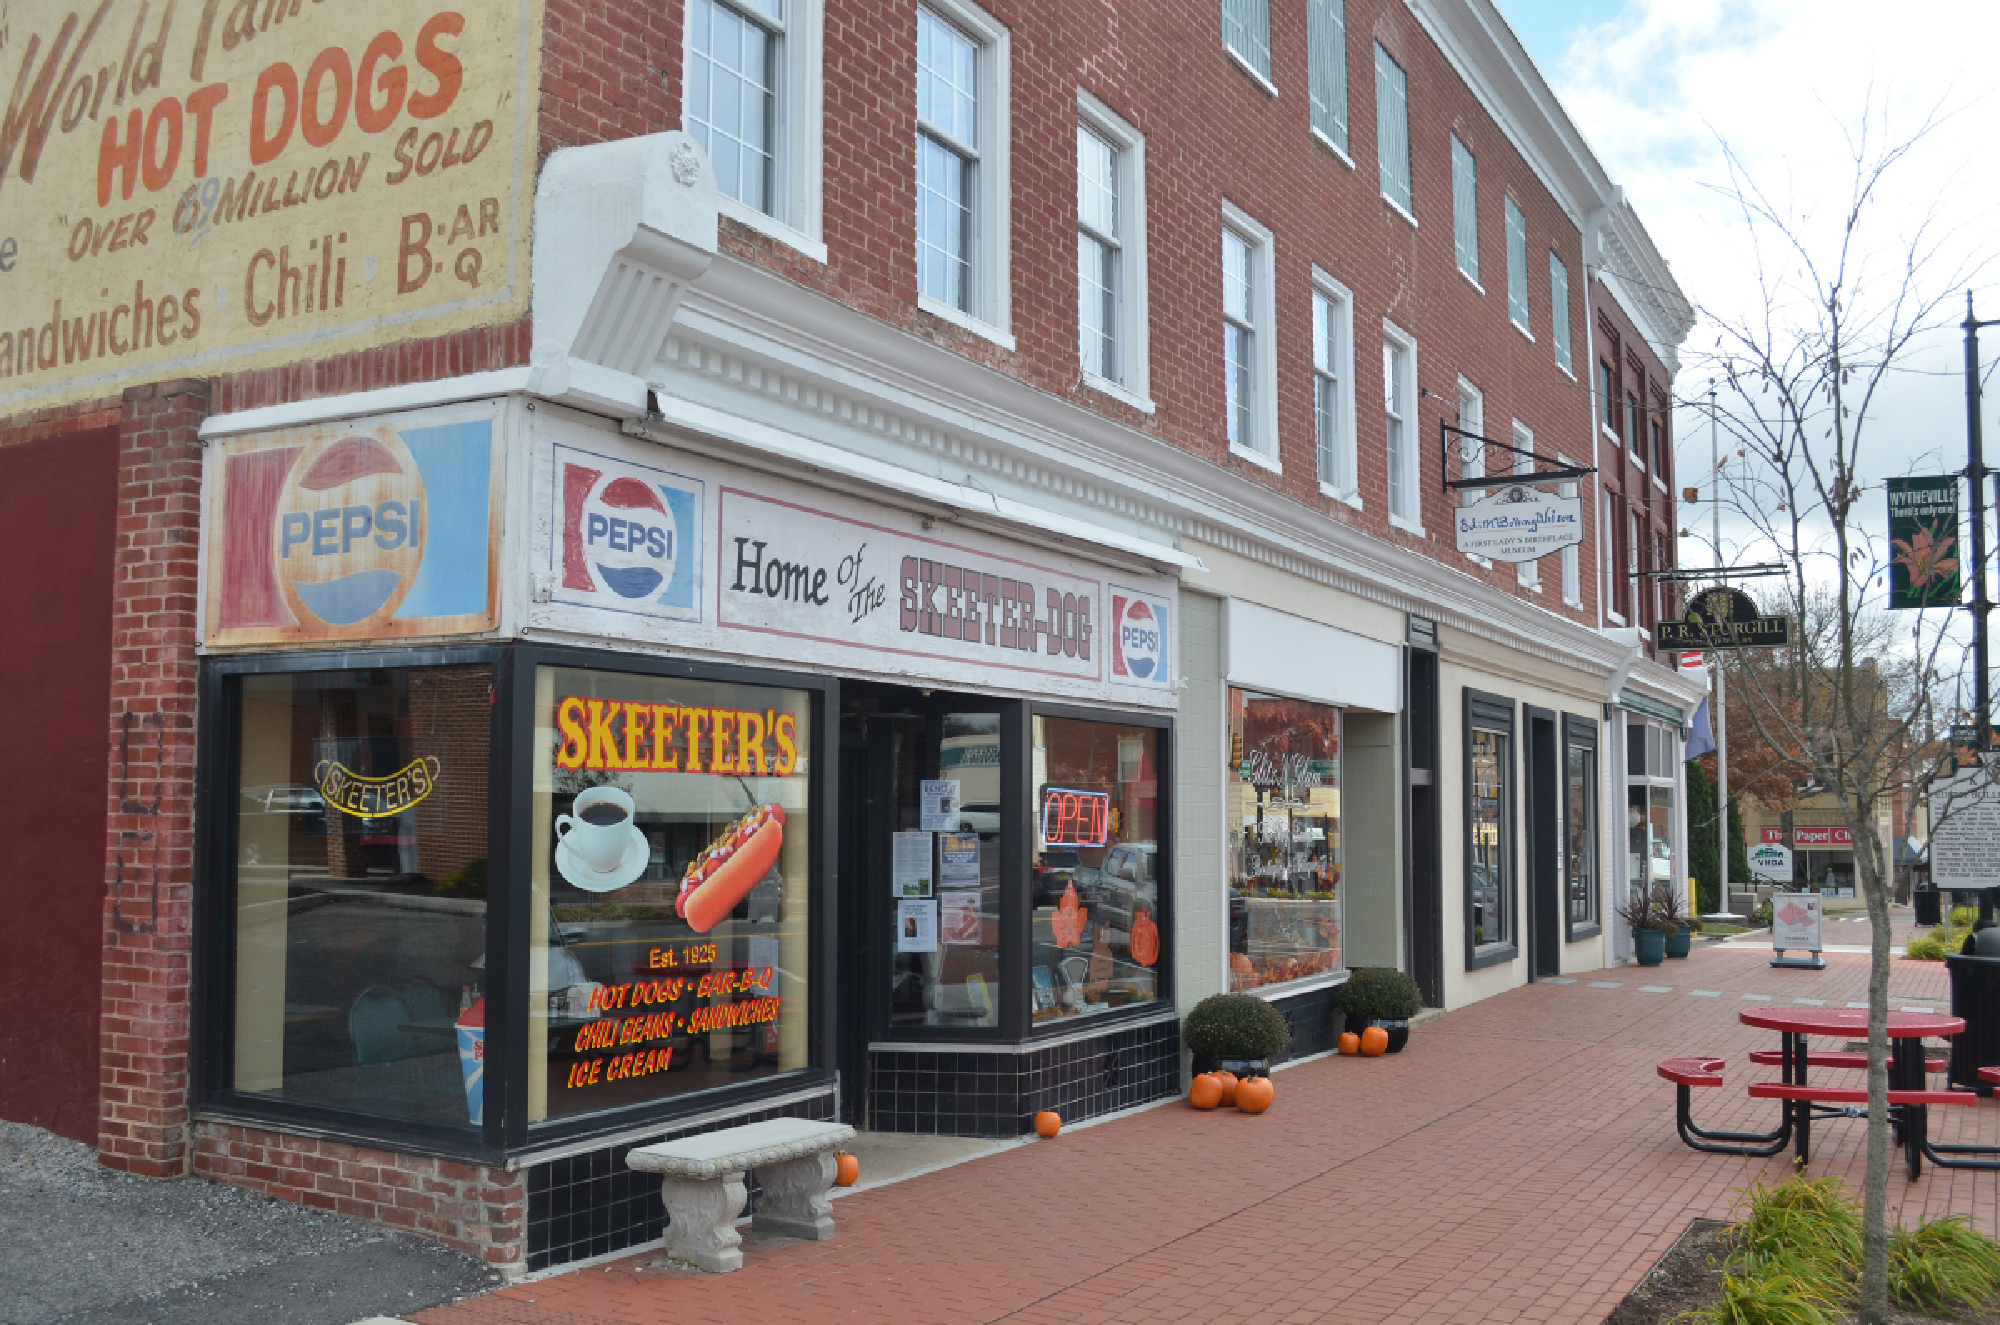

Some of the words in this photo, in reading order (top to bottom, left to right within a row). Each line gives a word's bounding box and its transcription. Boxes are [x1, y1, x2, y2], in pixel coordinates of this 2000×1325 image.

[0, 0, 174, 191] World
[97, 82, 228, 207] HOT
[250, 11, 466, 165] DOGS
[212, 151, 371, 224] MILLION
[245, 232, 348, 322] Chili
[281, 499, 420, 560] PEPSI
[587, 511, 674, 562] PEPSI
[730, 536, 829, 606] Home
[847, 575, 886, 626] The
[899, 554, 1093, 662] SKEETER-DOG
[1121, 624, 1160, 654] PEPSI
[1661, 626, 1673, 639] P.
[1678, 624, 1694, 639] R.
[555, 694, 798, 778] SKEETER'S
[326, 767, 427, 814] SKEETER'S
[1046, 792, 1108, 844] OPEN
[1796, 829, 1829, 843] Paper
[649, 945, 679, 969] Est.
[682, 942, 718, 965] 1925
[587, 982, 633, 1012] HOT
[629, 976, 685, 1007] DOGS
[696, 966, 773, 998] BAR-B-Q
[574, 1018, 621, 1053] CHILI
[619, 1011, 676, 1046] BEANS
[686, 996, 783, 1034] SANDWICHES
[567, 1057, 603, 1089] ICE
[606, 1046, 674, 1082] CREAM
